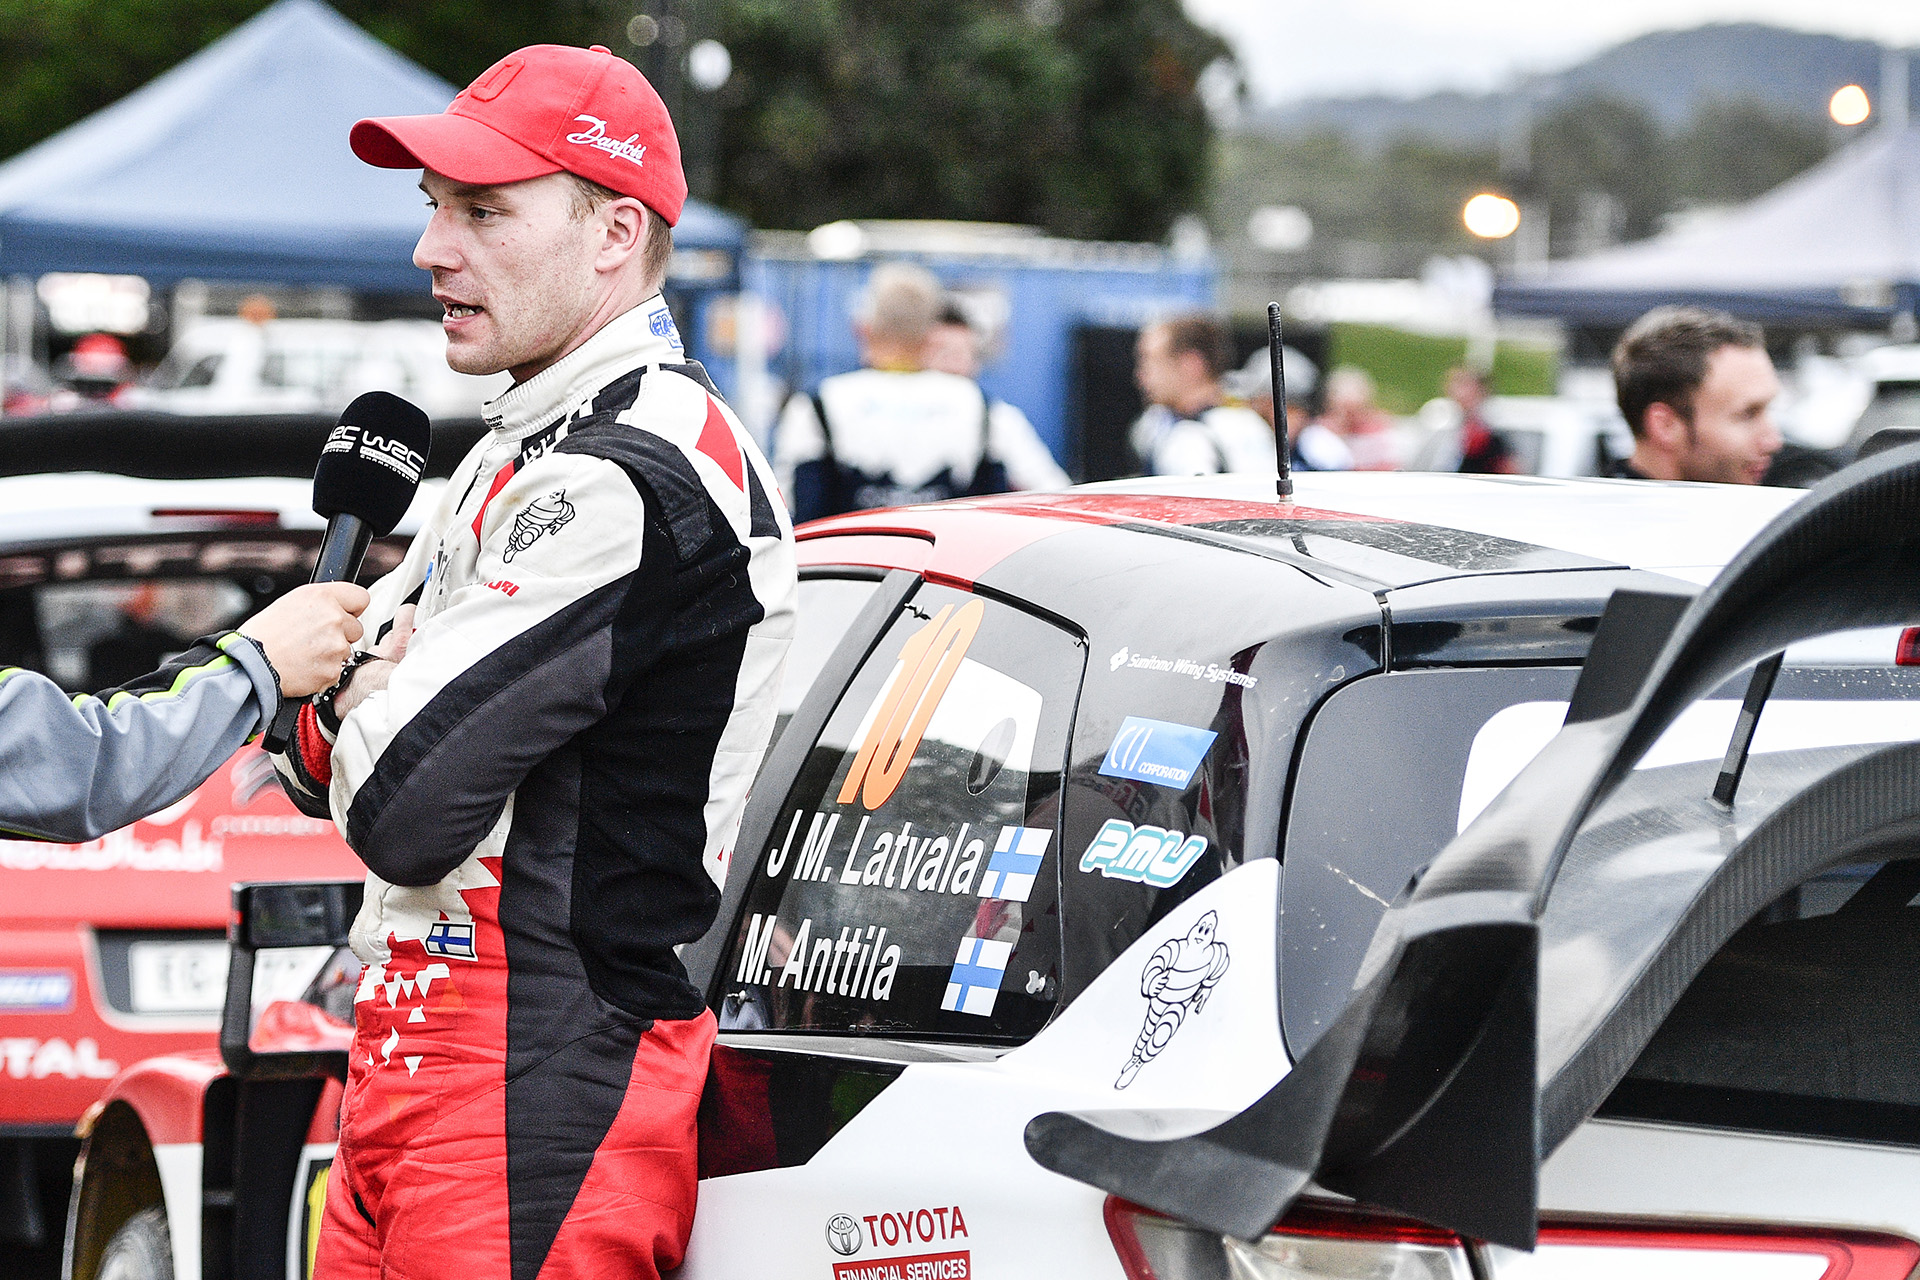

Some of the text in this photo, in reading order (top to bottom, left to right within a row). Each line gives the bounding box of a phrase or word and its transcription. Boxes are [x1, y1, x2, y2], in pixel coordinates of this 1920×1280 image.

[566, 114, 648, 167] Danfoss
[362, 430, 425, 473] WRC
[1127, 653, 1258, 689] Sumitomo Wiring Systems
[836, 598, 985, 811] 10
[1138, 762, 1189, 783] CORPORATION
[766, 809, 985, 895] J M. Latvala
[736, 912, 902, 1001] M. Anttila
[863, 1206, 968, 1247] TOYOTA
[838, 1258, 967, 1280] FINANCIAL SERVICES
